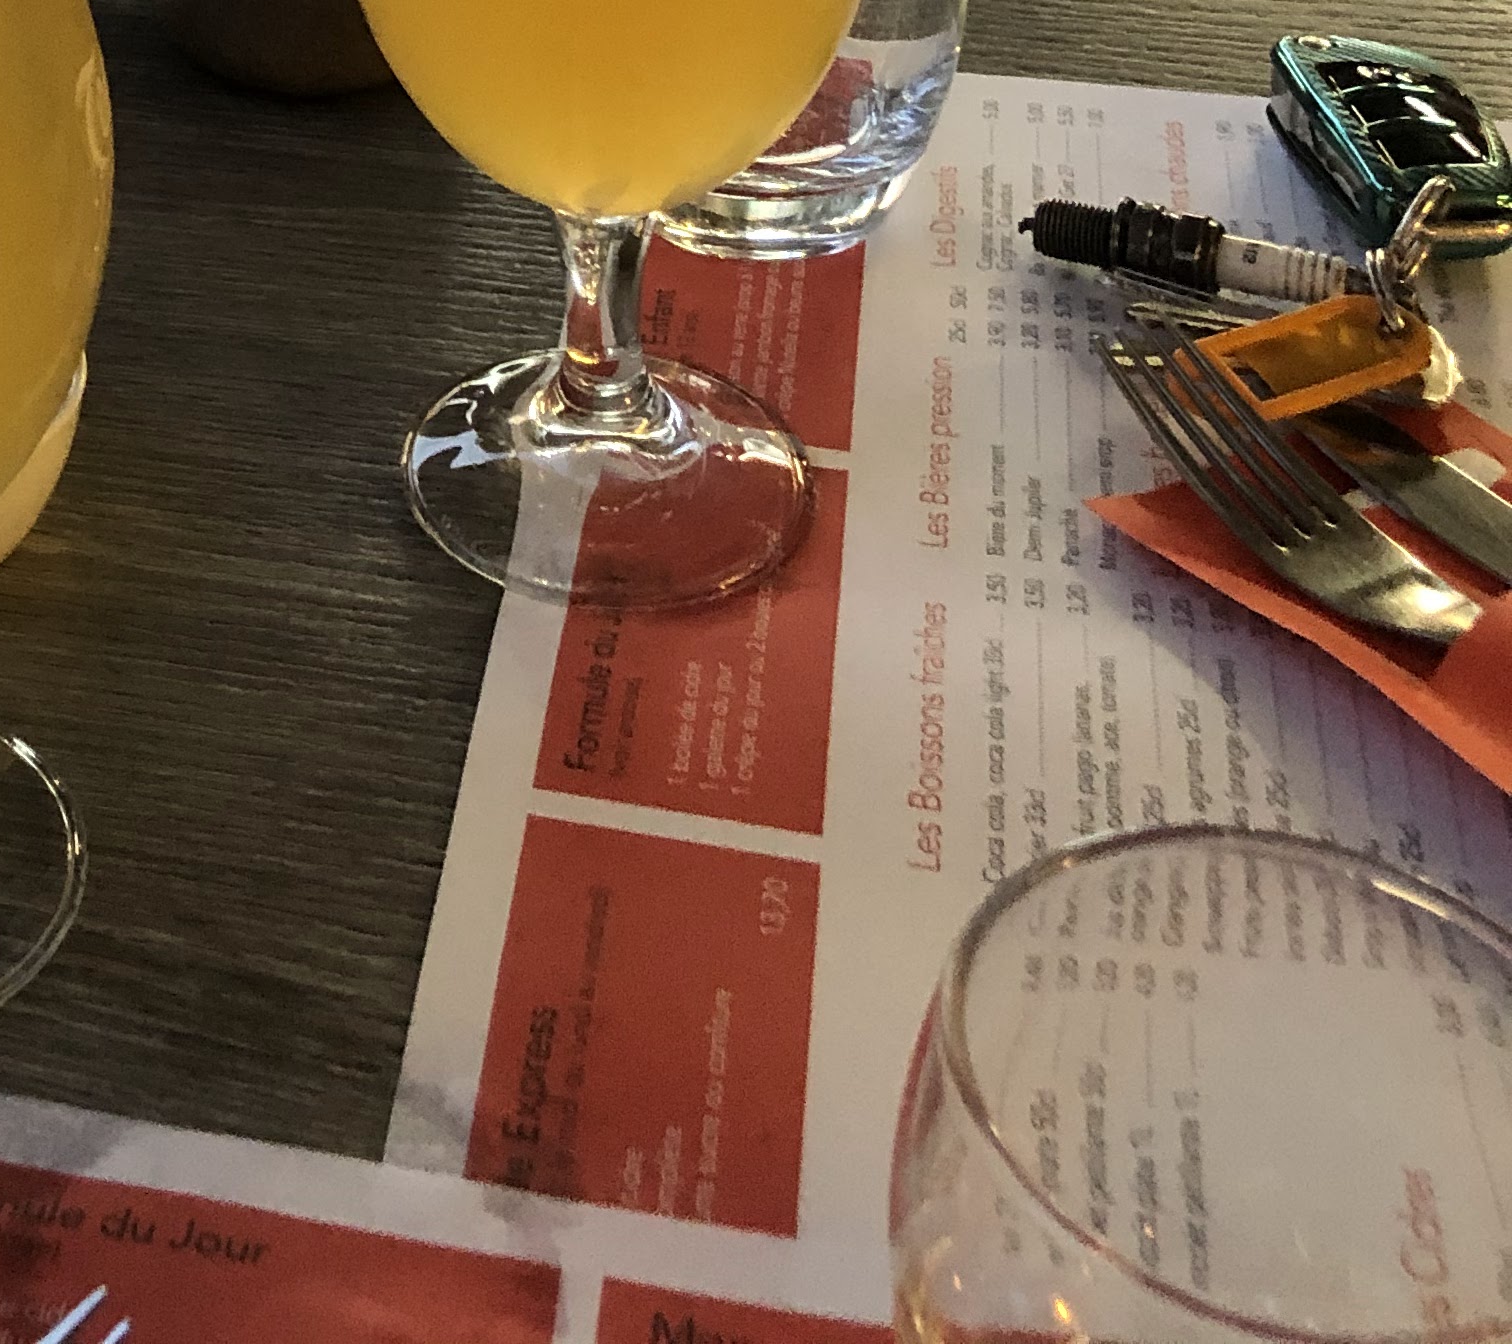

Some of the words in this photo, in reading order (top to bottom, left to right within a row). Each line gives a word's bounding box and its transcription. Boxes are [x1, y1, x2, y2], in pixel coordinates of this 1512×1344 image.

[930, 238, 957, 267] Les
[924, 355, 960, 437] pression
[919, 442, 951, 505] Bières
[916, 511, 950, 547] Les
[910, 600, 946, 684] fraîches
[563, 664, 612, 770] Formule
[907, 692, 945, 812] Boissons
[904, 821, 942, 872] Les
[501, 1005, 558, 1143] Express
[100, 1205, 156, 1247] du
[167, 1217, 268, 1265] Jour
